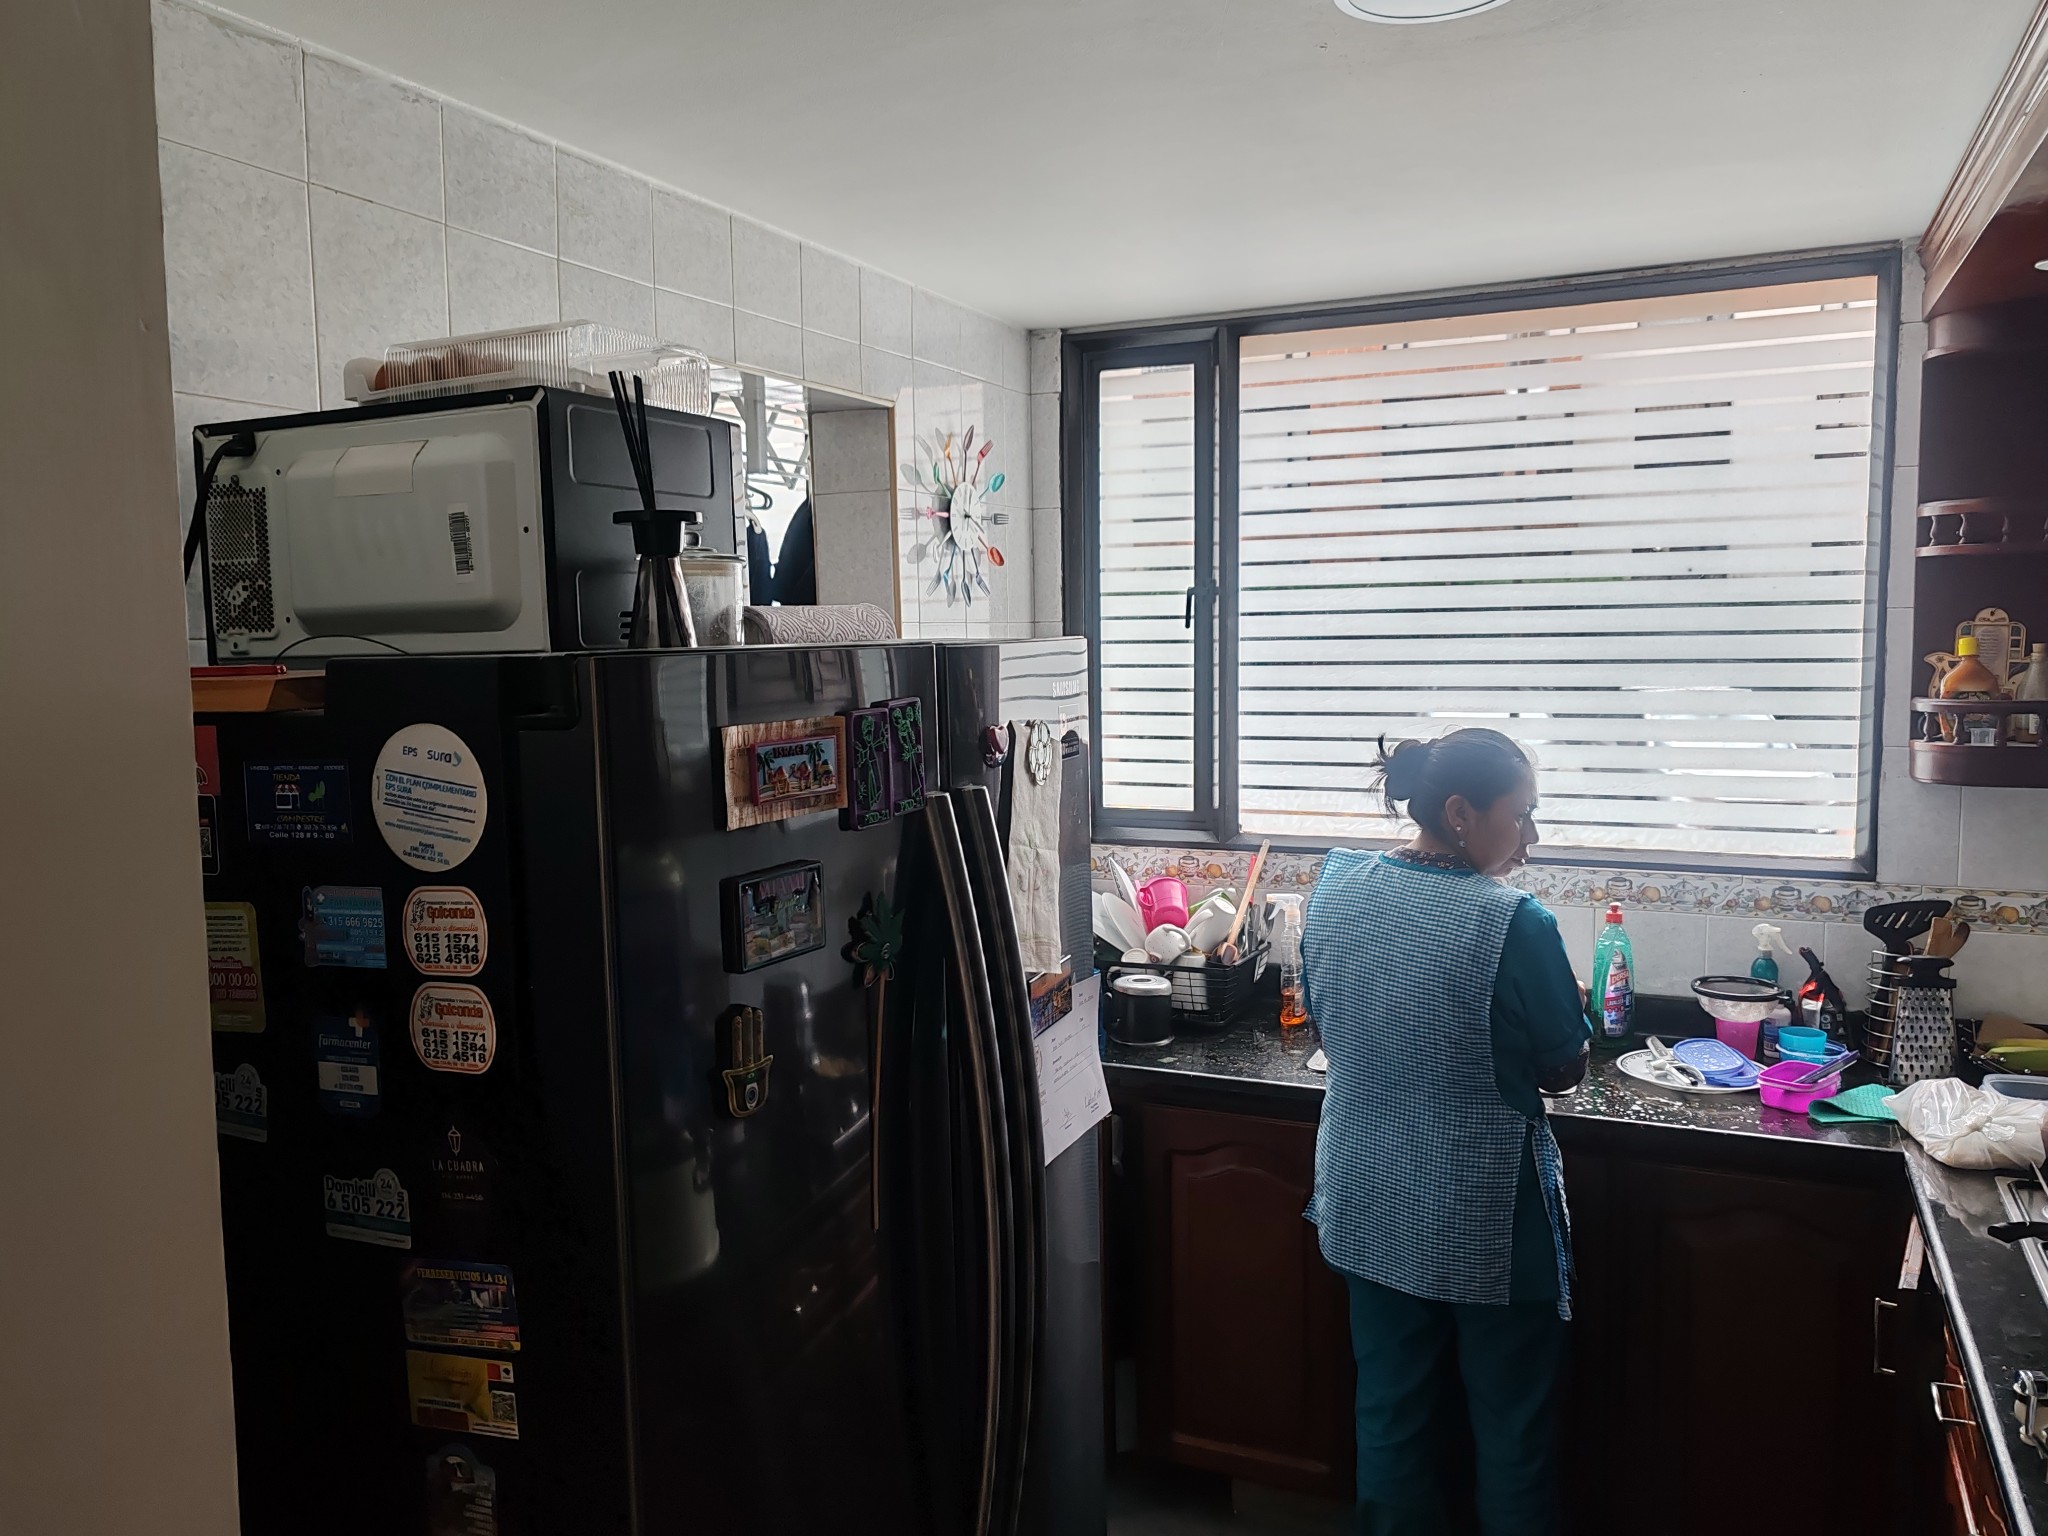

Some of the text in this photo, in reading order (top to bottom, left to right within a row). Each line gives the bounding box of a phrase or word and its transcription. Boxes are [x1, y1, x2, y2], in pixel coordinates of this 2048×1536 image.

[1052, 680, 1079, 698] SAMSUNG
[402, 746, 452, 763] EPS sura
[772, 743, 804, 758] ISRAEL
[272, 773, 301, 782] TIENDA
[385, 774, 477, 798] CON EL PLAN COMPLEMENTARIO
[385, 783, 412, 794] EPS SURA
[276, 815, 326, 823] CAMPESTRE
[427, 906, 475, 923] Golconda
[328, 916, 343, 926] 315
[362, 918, 383, 928] 9625
[414, 933, 479, 943] 615 1571
[415, 943, 480, 954] 615 1584
[416, 953, 480, 964] 625 4518
[435, 1003, 484, 1020] Golconda
[421, 1028, 486, 1042] 615 1571
[423, 1038, 487, 1052] 615 1584
[424, 1048, 486, 1063] 625 4518
[235, 1094, 262, 1115] 222
[432, 1160, 485, 1173] LA CUADRA
[380, 1178, 392, 1189] 24
[327, 1192, 406, 1219] 6 505 222
[416, 1268, 481, 1281] FERRESERVICIOS
[483, 1272, 493, 1283] LA
